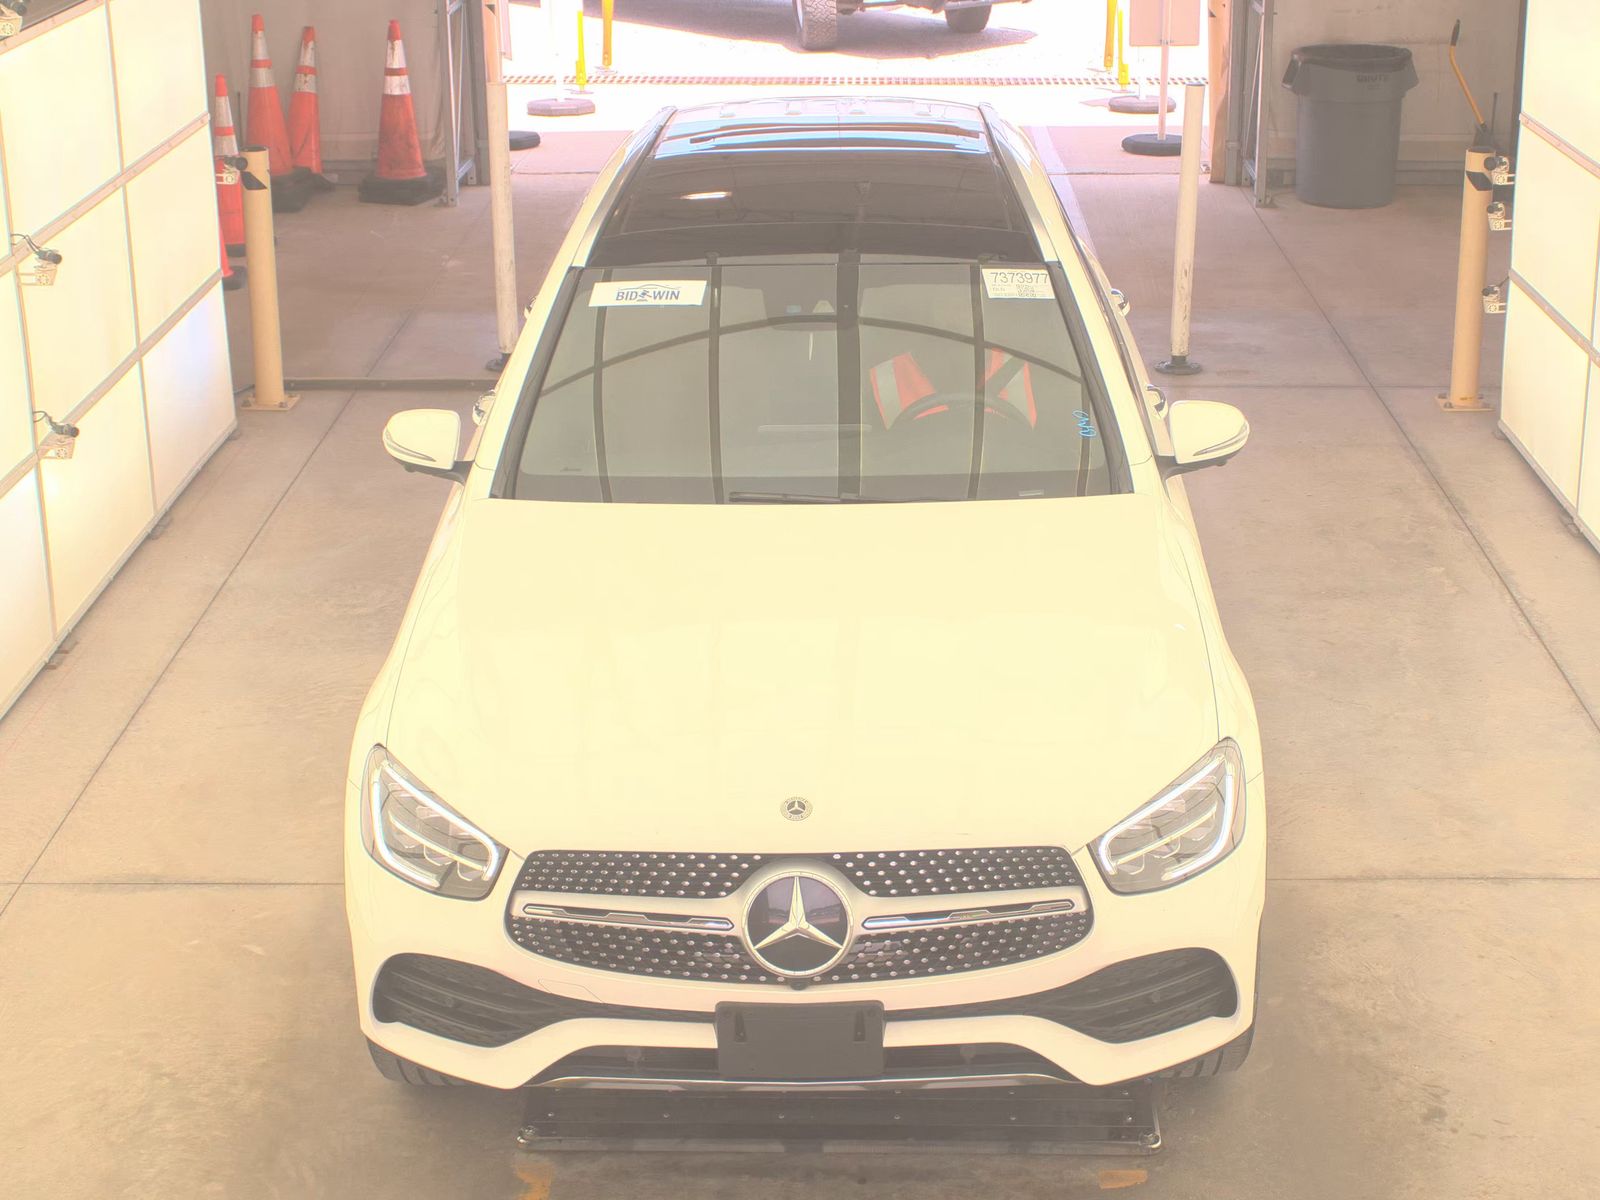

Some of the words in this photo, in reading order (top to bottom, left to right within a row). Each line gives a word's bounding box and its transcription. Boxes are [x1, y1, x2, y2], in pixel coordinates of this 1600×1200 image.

[990, 271, 1048, 284] 7373977
[616, 291, 638, 301] BID
[652, 290, 680, 300] WIN
